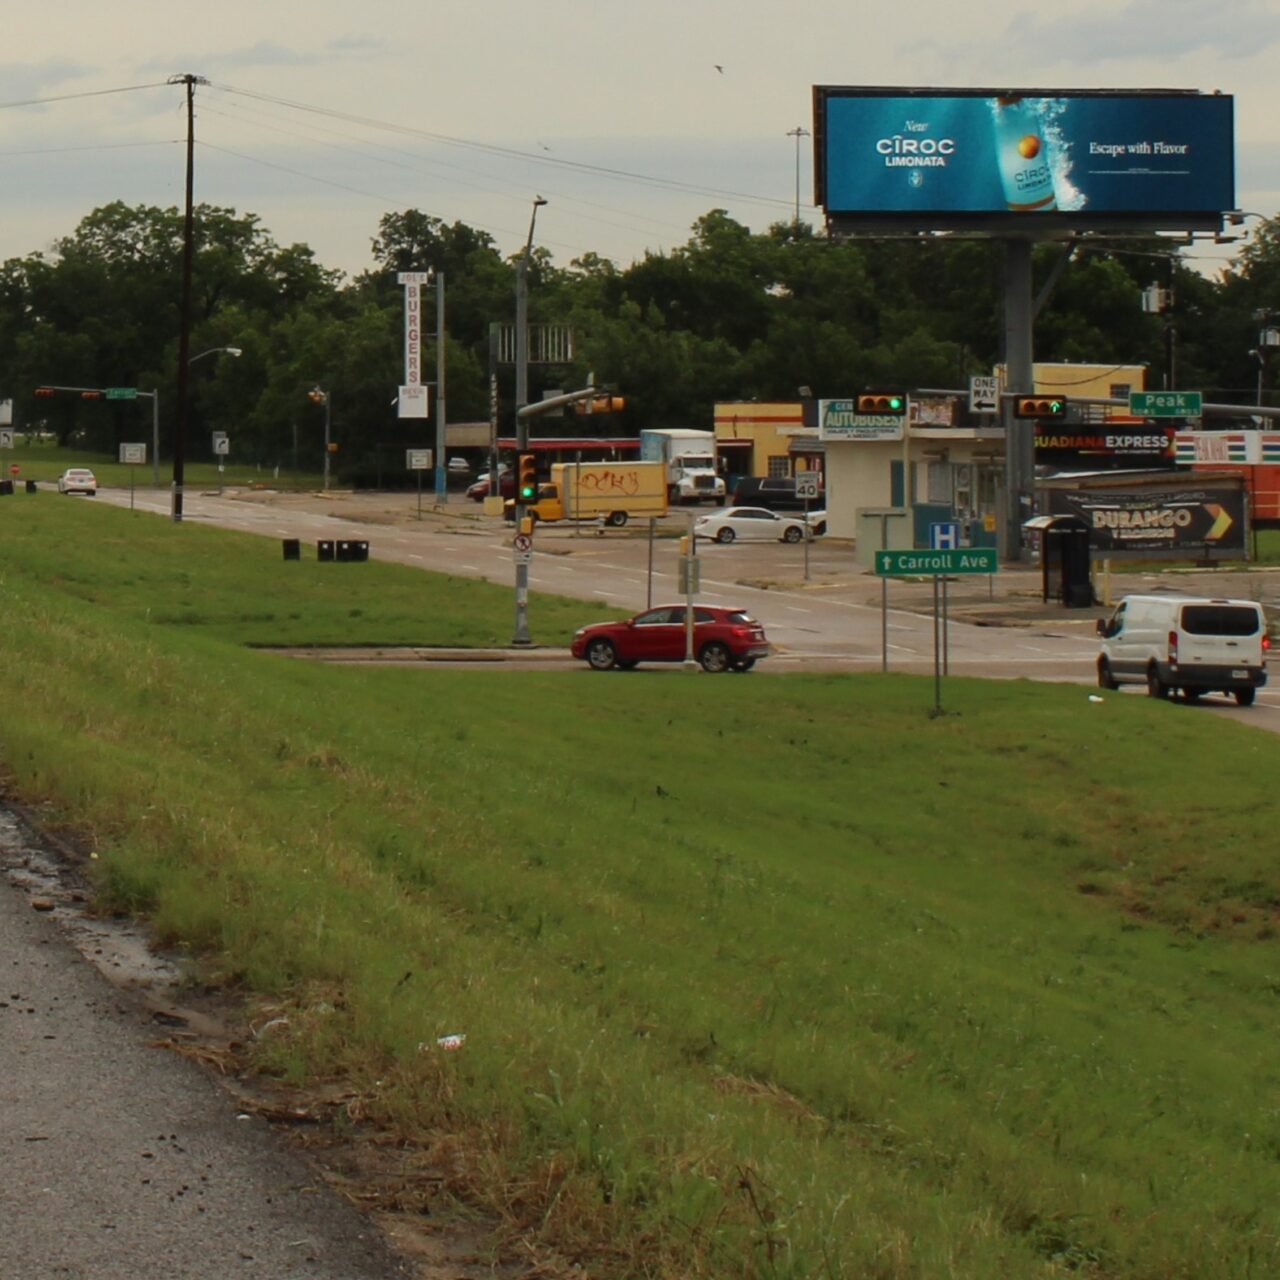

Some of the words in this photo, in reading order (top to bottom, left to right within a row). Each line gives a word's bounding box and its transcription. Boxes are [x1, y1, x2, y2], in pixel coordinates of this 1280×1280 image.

[903, 120, 929, 132] New
[876, 134, 955, 154] CÎROC
[1089, 141, 1125, 157] Escape
[1127, 141, 1151, 154] with
[1153, 141, 1188, 154] Flavor
[885, 156, 946, 167] LIMONATA
[407, 286, 419, 383] BURGERS
[974, 378, 996, 388] ONE
[973, 389, 996, 398] WAY
[1145, 394, 1186, 407] Peak
[1105, 435, 1169, 448] EXPRESS
[797, 485, 816, 495] 40
[1092, 508, 1192, 528] DURANGO
[934, 524, 956, 550] H
[898, 554, 953, 569] Carroll
[960, 555, 988, 568] Ave
